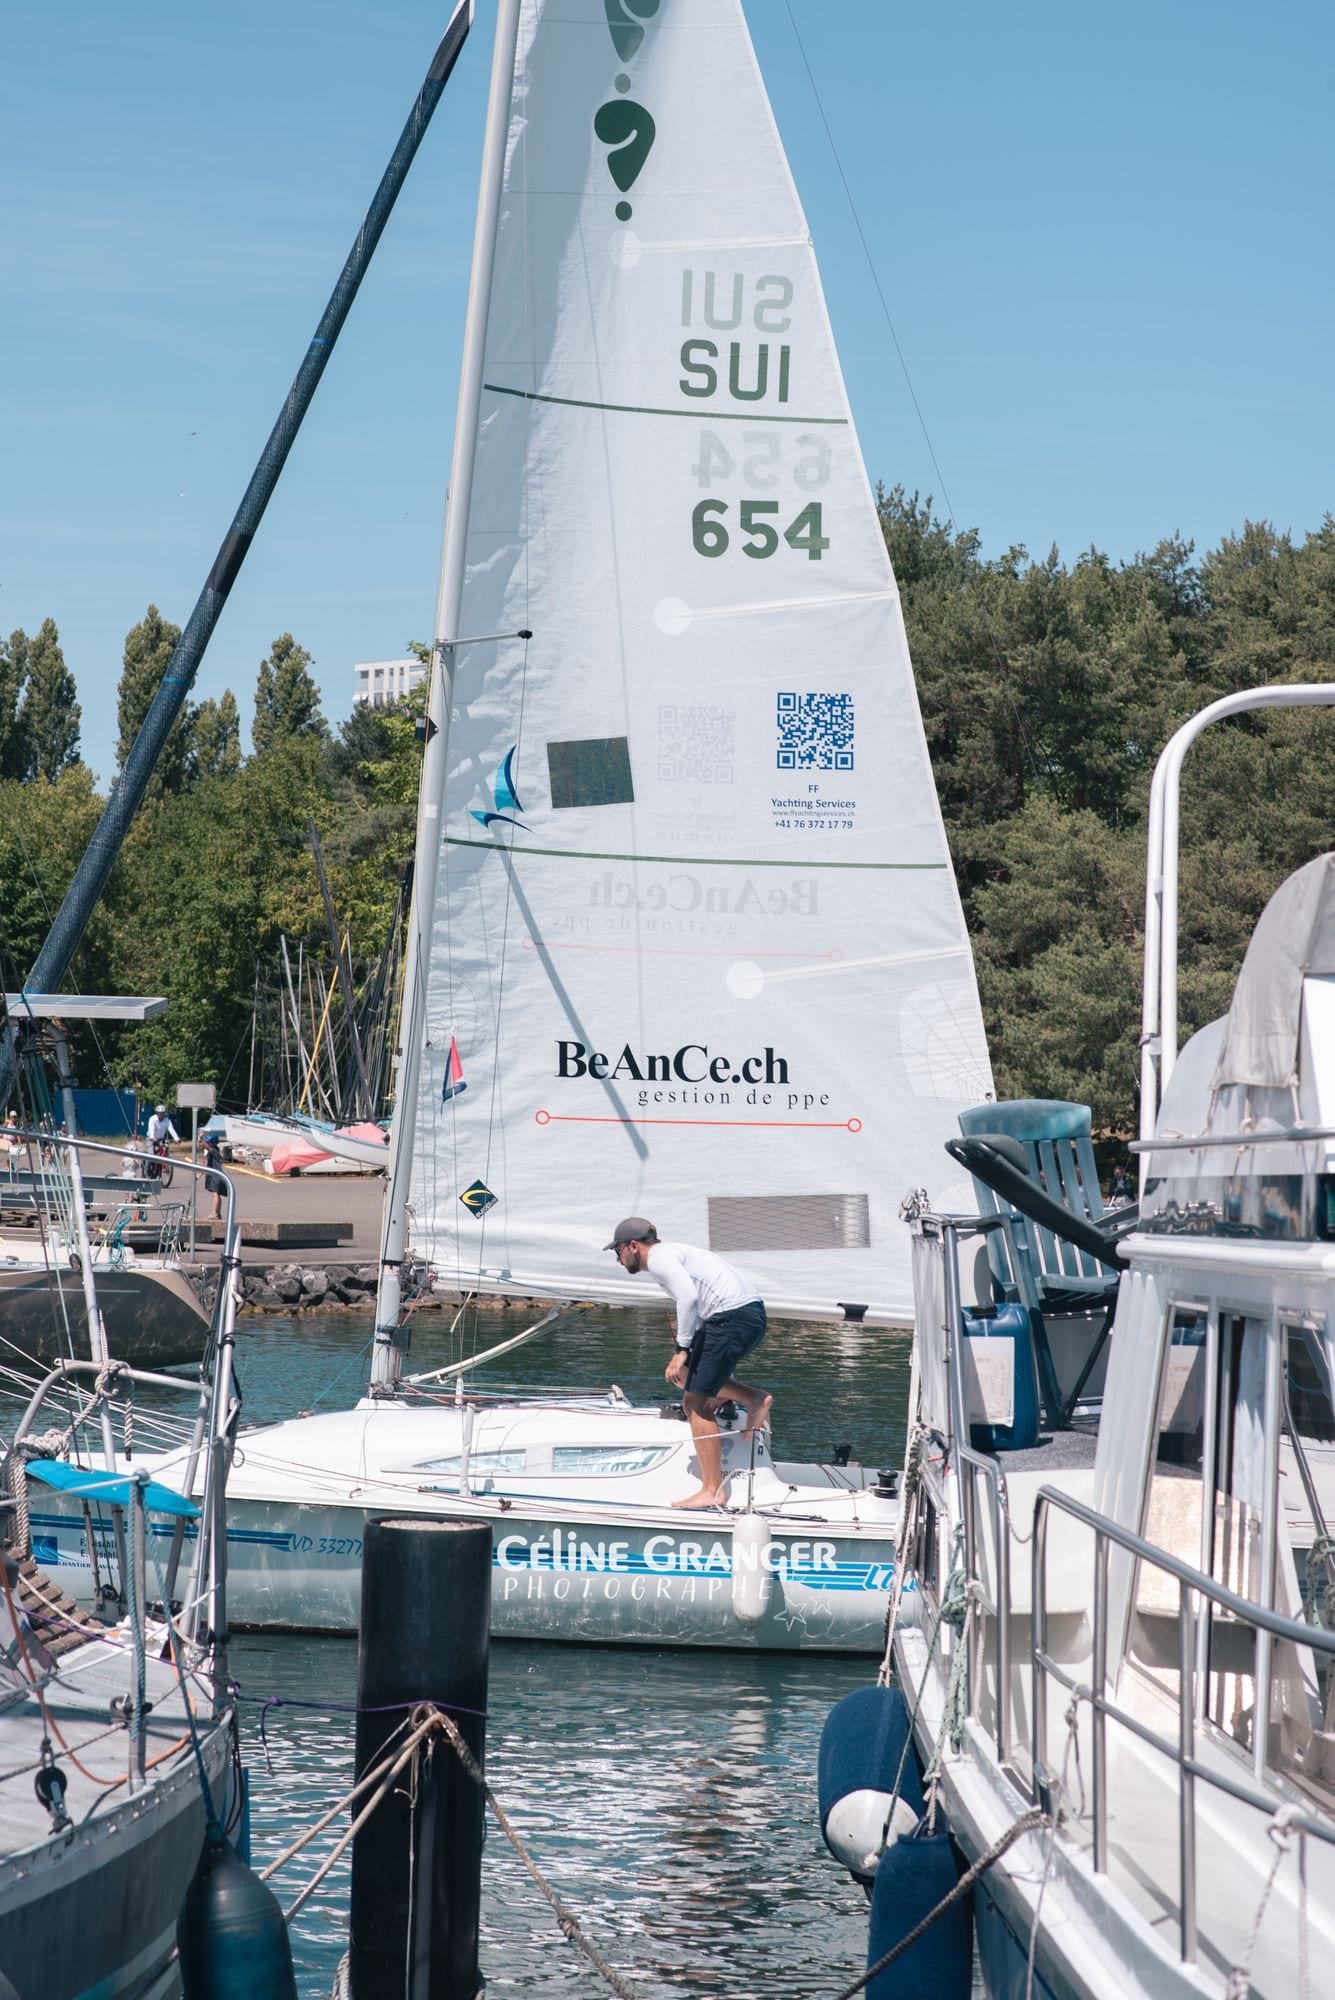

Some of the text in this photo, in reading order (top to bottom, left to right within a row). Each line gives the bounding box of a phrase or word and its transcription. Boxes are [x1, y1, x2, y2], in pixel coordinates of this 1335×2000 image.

[679, 339, 791, 403] SUI
[692, 499, 830, 560] 654
[808, 784, 820, 793] FF
[771, 798, 857, 810] Yachting Services
[774, 820, 853, 829] +41 76 372 17 79
[553, 1040, 791, 1084] BeAnCe.ch
[637, 1088, 830, 1110] gestion de ppe
